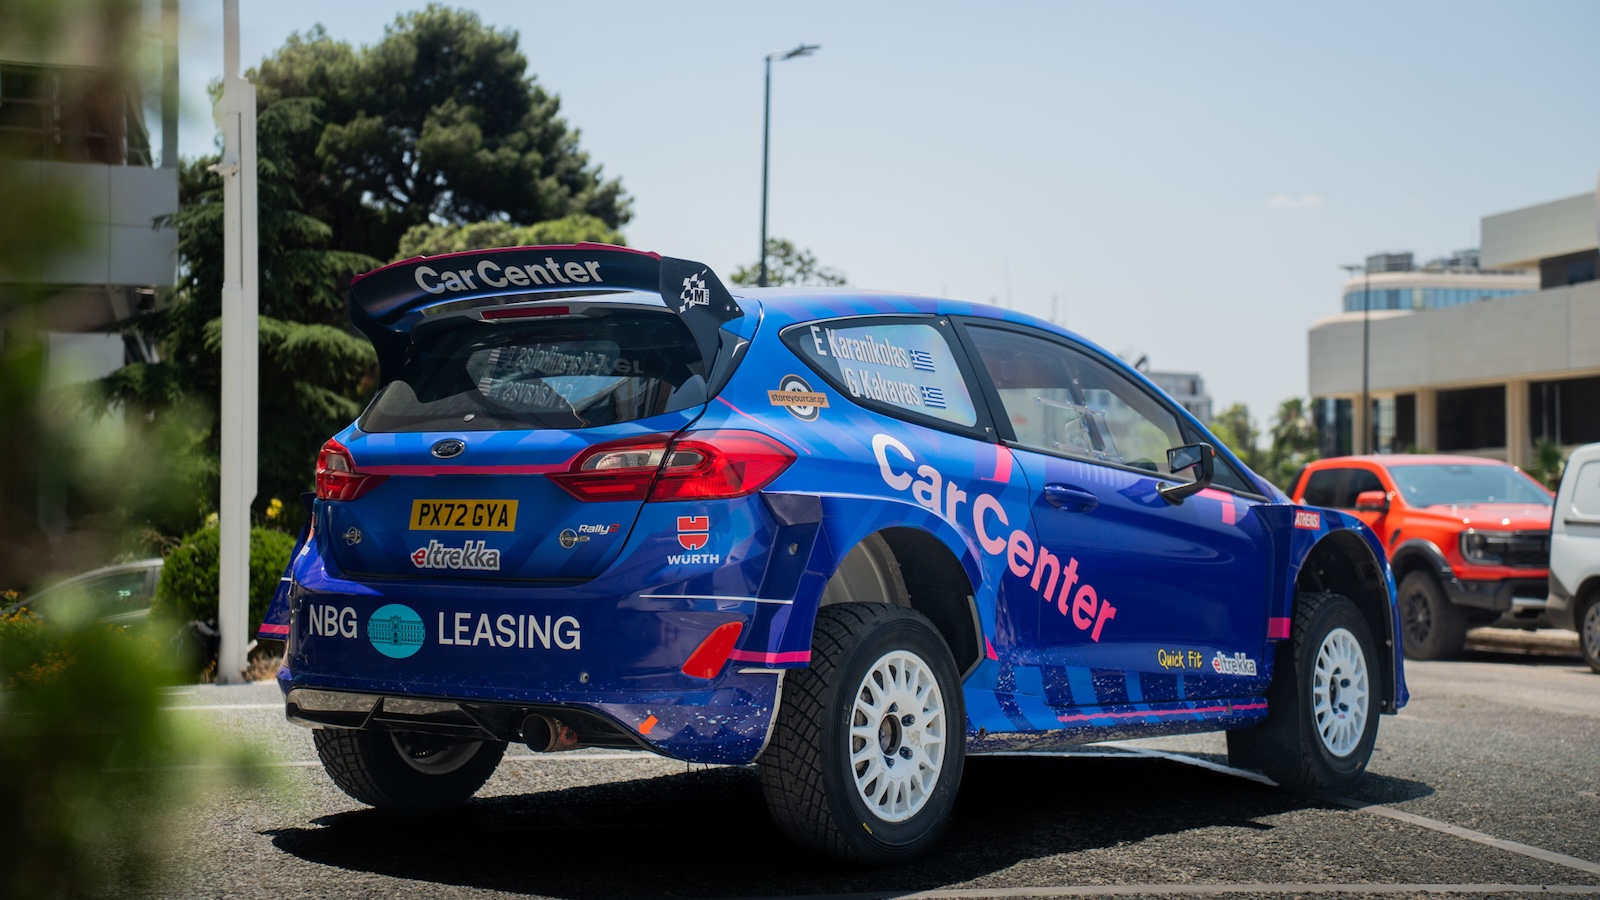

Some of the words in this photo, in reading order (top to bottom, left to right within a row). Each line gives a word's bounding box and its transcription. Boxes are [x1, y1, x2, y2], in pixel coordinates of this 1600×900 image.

[694, 289, 705, 303] M
[810, 325, 827, 356] E
[825, 327, 910, 369] Karanikolas
[844, 367, 862, 398] G
[858, 369, 921, 406] Kakavas
[770, 393, 826, 406] storeyourcar.gr
[418, 503, 468, 527] PX72
[471, 503, 508, 527] GYA
[578, 523, 621, 535] Rally2
[411, 541, 500, 570] eltrekka
[667, 554, 720, 565] WÜRTH
[308, 604, 358, 639] NBG
[438, 611, 581, 651] LEASING
[1157, 649, 1186, 671] Quick
[1187, 650, 1203, 669] Fit
[1211, 651, 1257, 676] eltrekka
